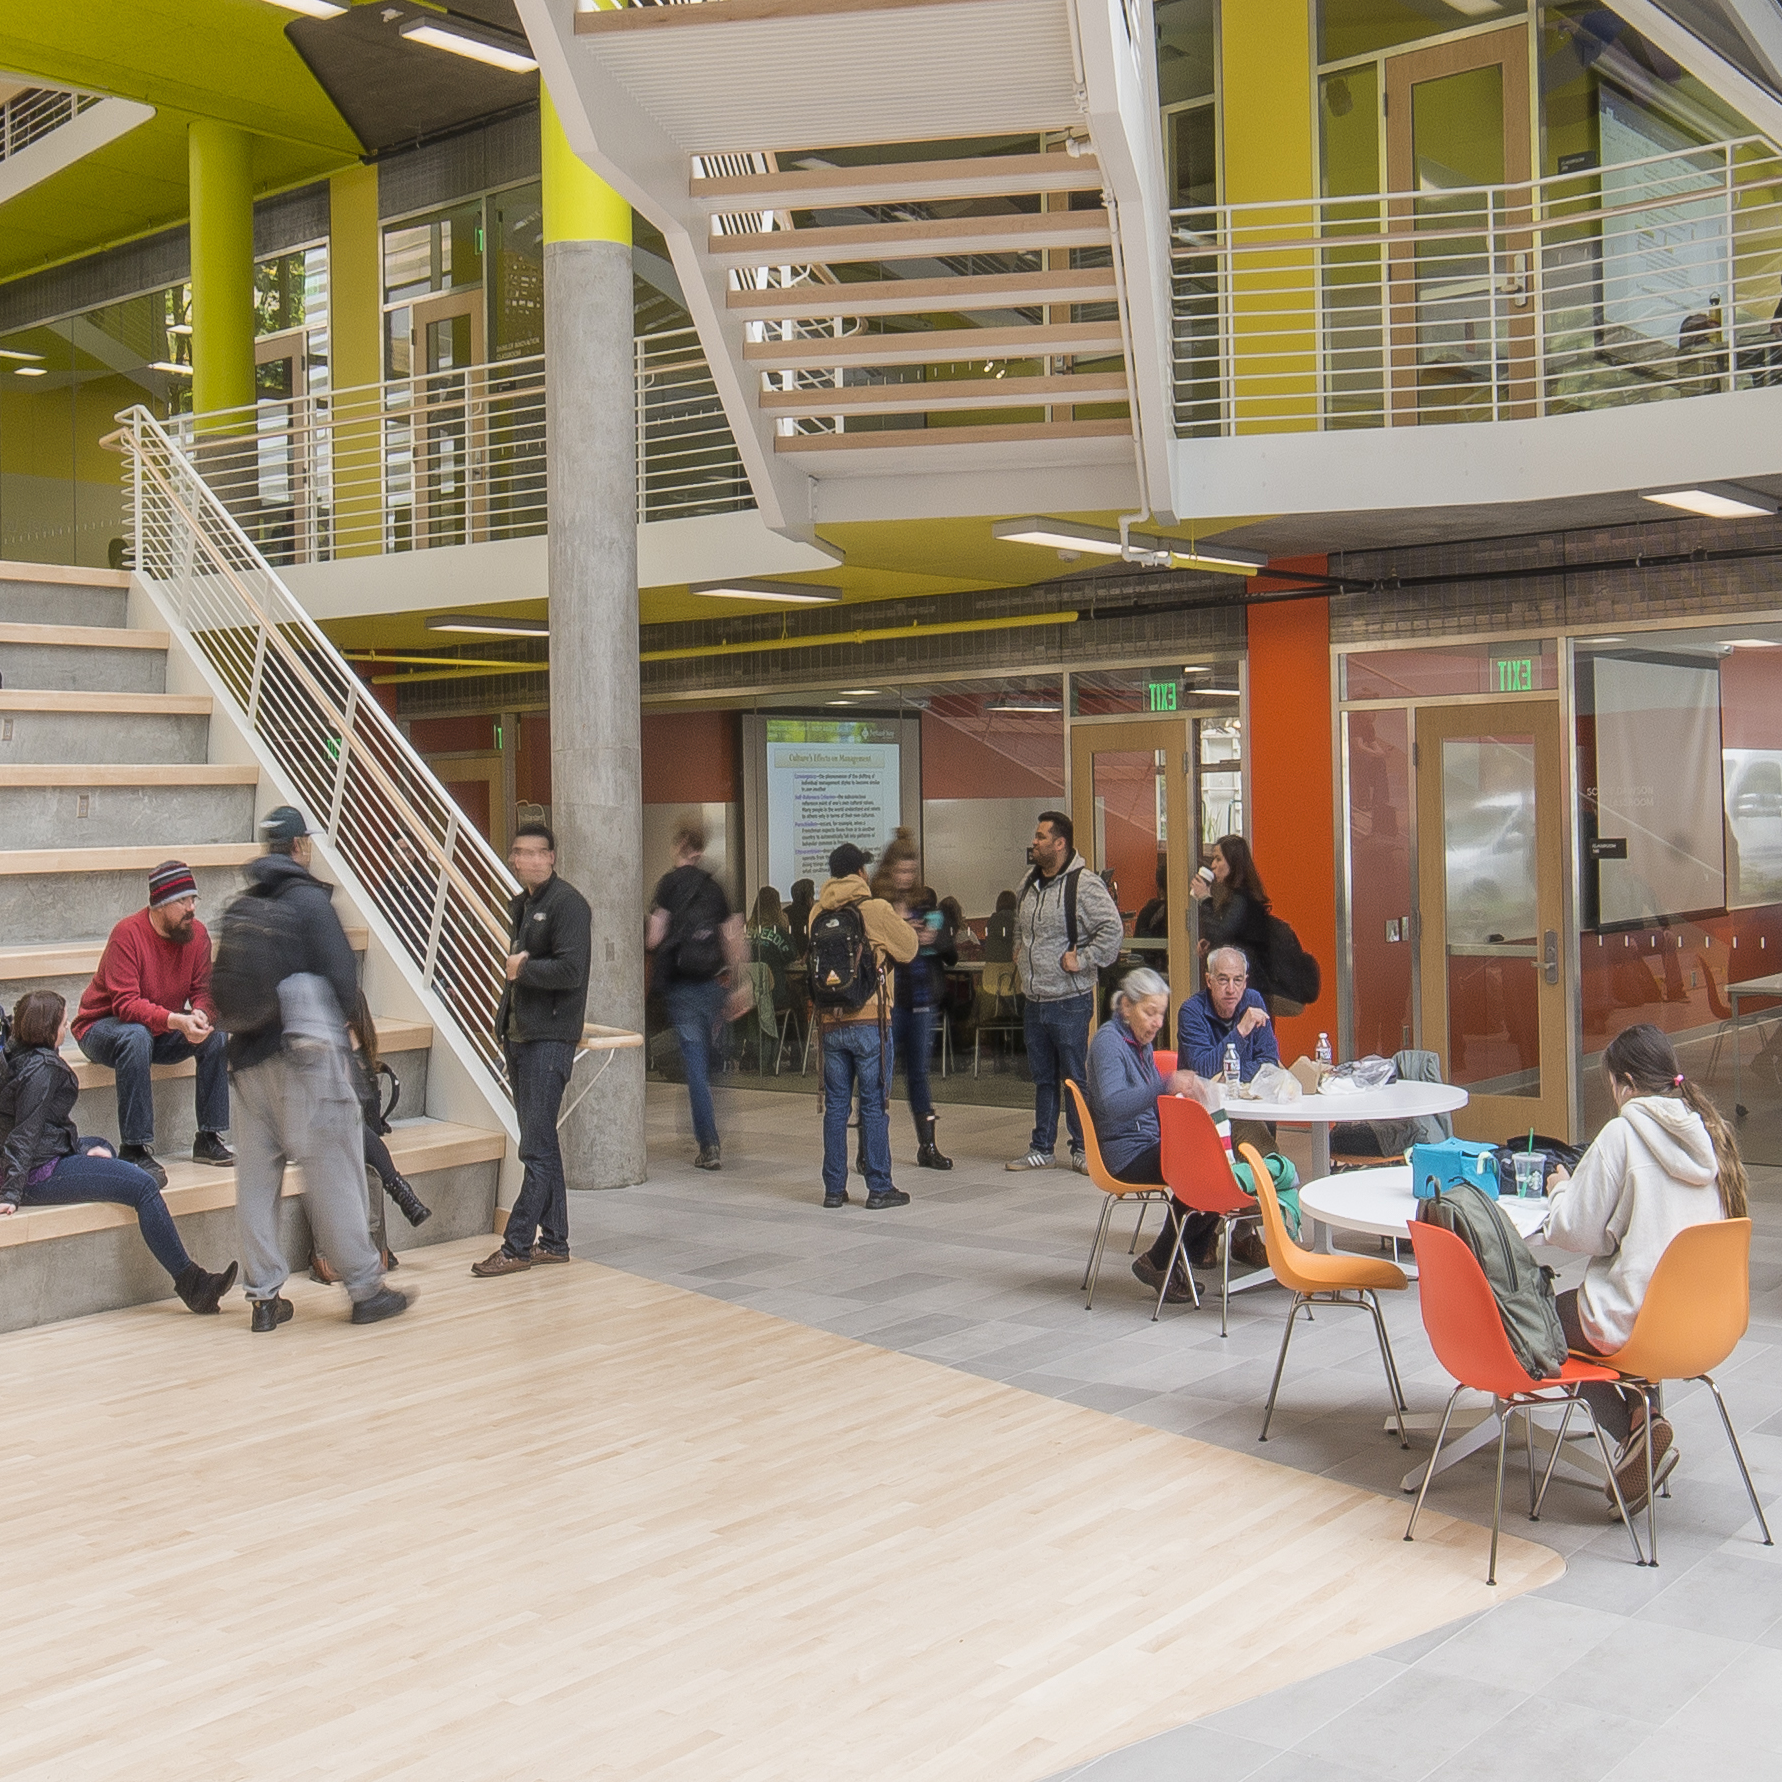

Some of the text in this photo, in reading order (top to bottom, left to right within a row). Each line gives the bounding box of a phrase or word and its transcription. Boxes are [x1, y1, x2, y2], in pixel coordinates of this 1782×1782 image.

[789, 752, 813, 762] Culture's
[814, 753, 831, 762] Effects
[839, 754, 872, 765] Management
